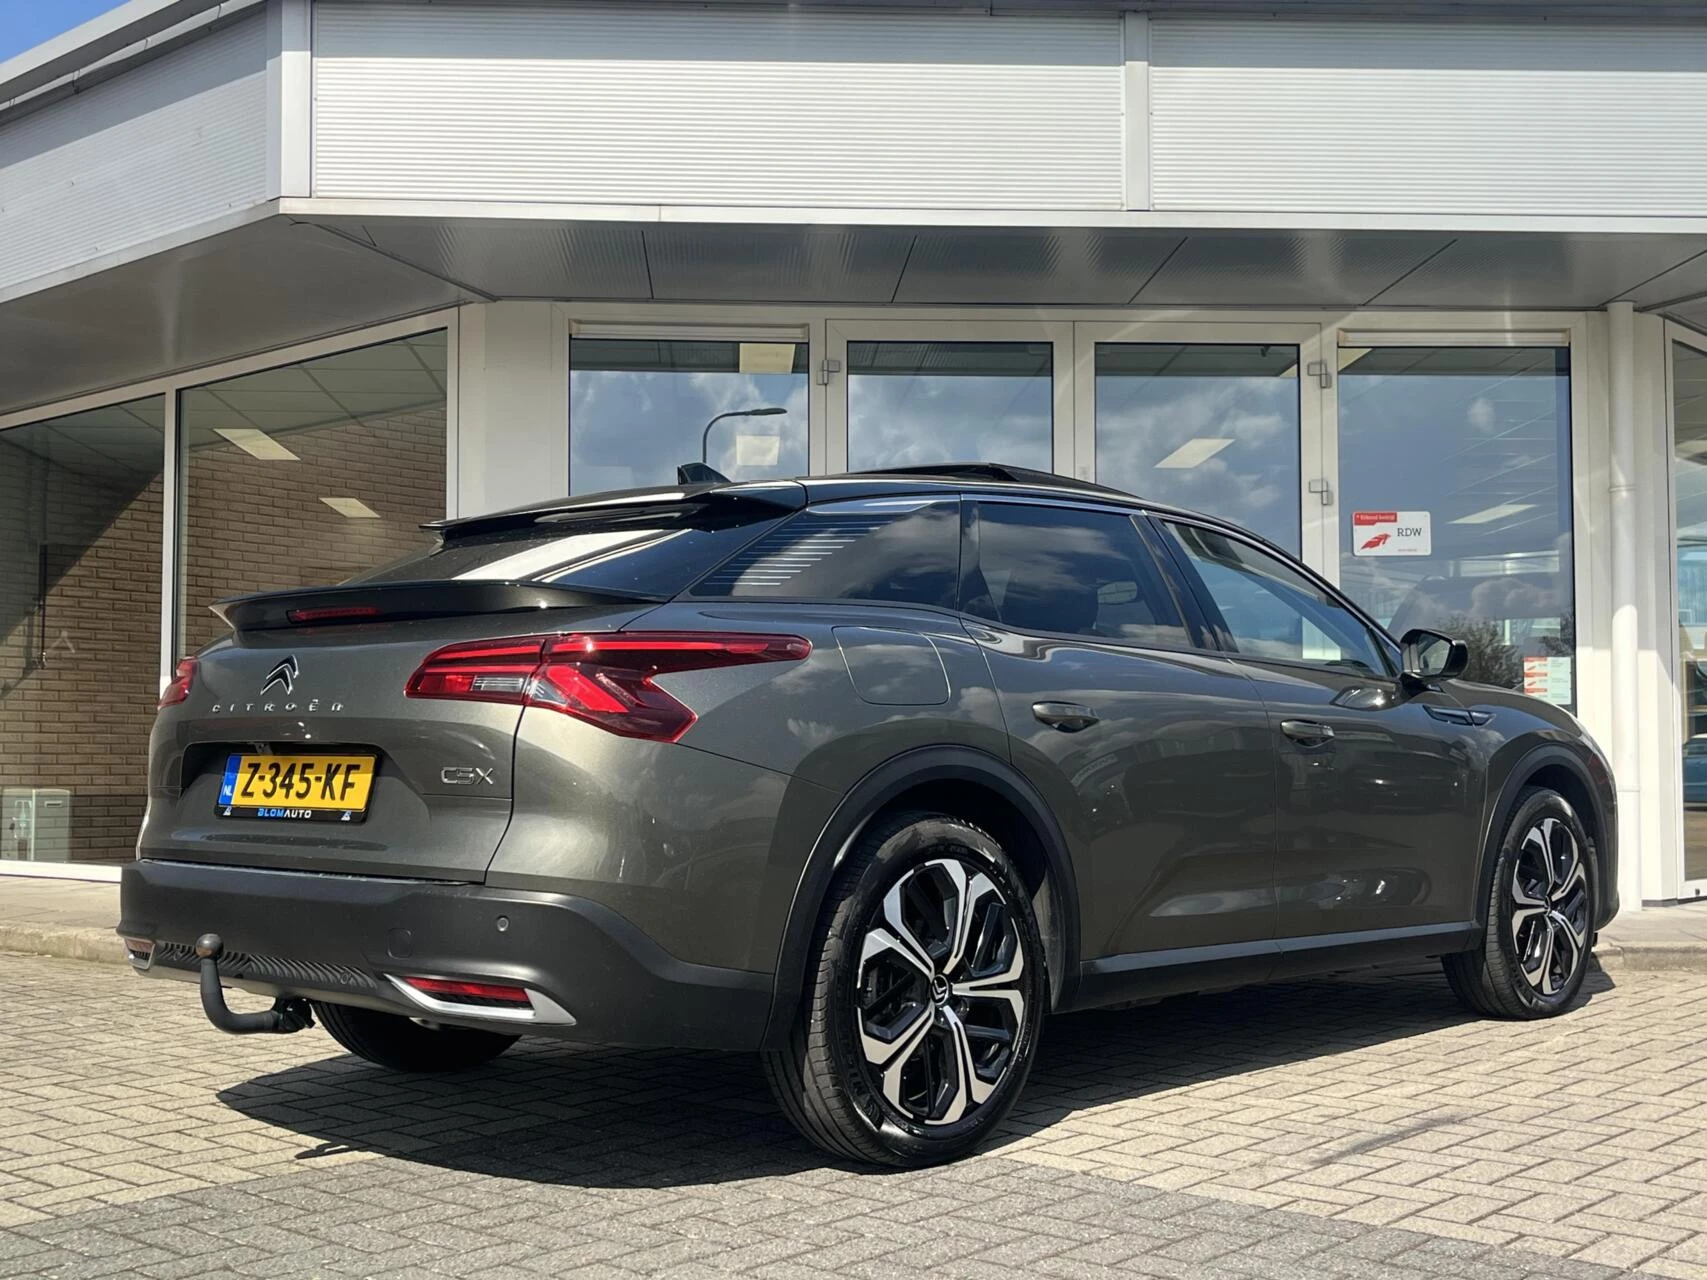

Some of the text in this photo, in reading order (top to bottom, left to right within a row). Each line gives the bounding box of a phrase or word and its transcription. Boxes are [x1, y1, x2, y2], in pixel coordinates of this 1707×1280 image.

[1397, 527, 1422, 537] RDW
[212, 698, 344, 713] CITROËN
[240, 762, 361, 802] Z-345-KF
[223, 785, 233, 797] NL
[257, 808, 312, 819] BLOMAUTO
